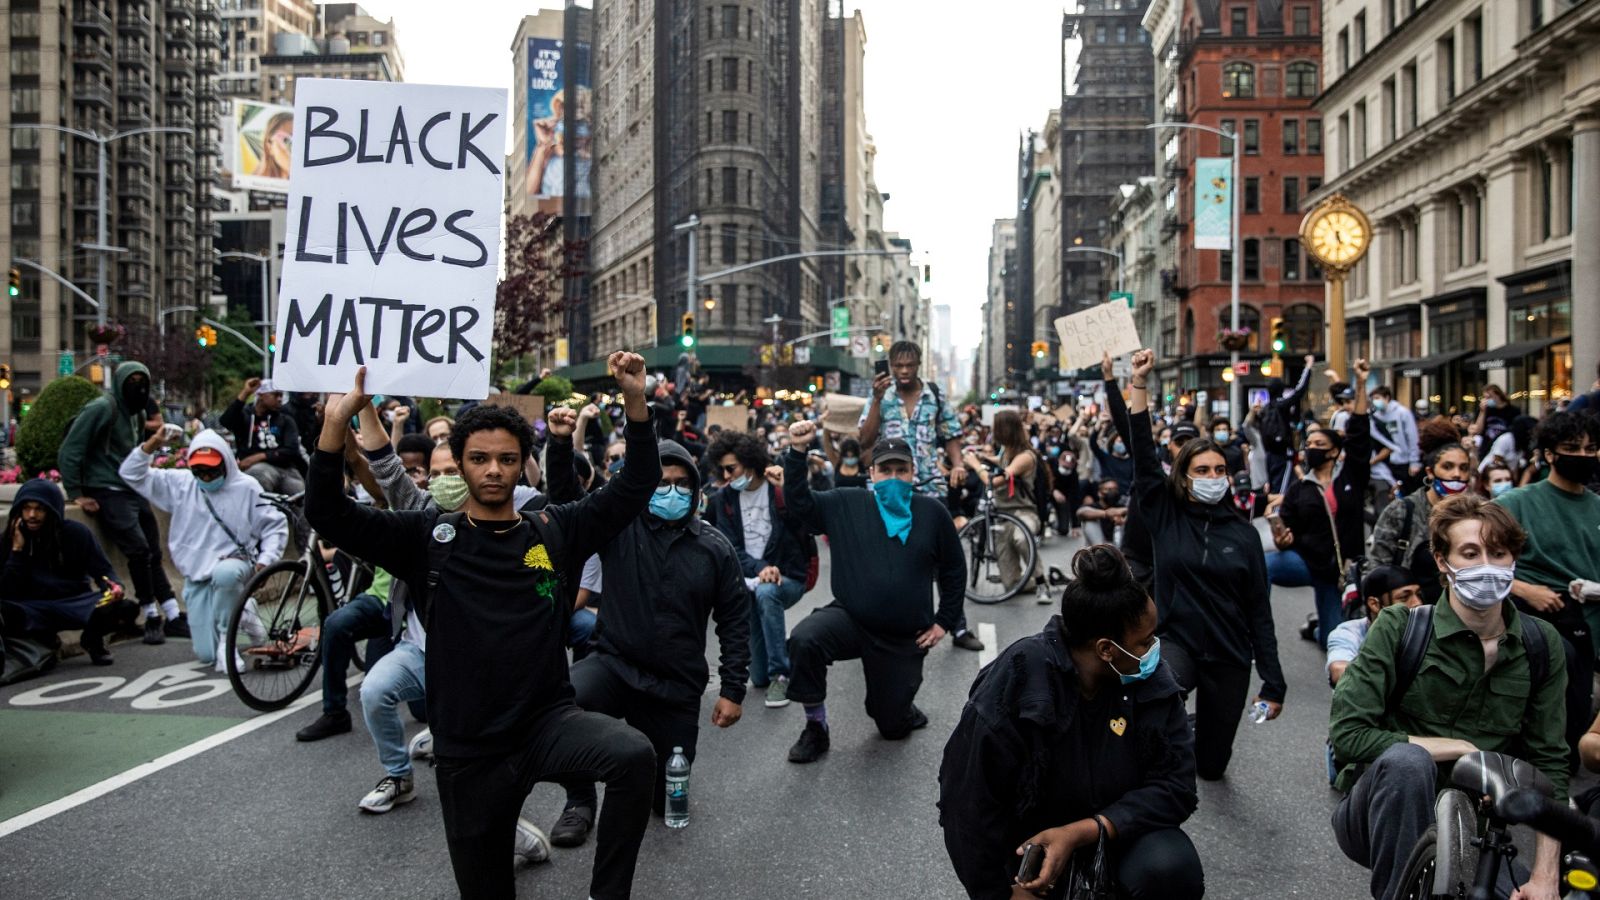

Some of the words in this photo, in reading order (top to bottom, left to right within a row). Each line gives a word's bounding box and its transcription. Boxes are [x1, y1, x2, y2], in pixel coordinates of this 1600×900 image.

[538, 49, 561, 60] IT'S
[533, 58, 557, 70] OKAY
[541, 70, 558, 79] TO
[304, 105, 501, 174] BLACK
[1063, 307, 1117, 337] BLACK
